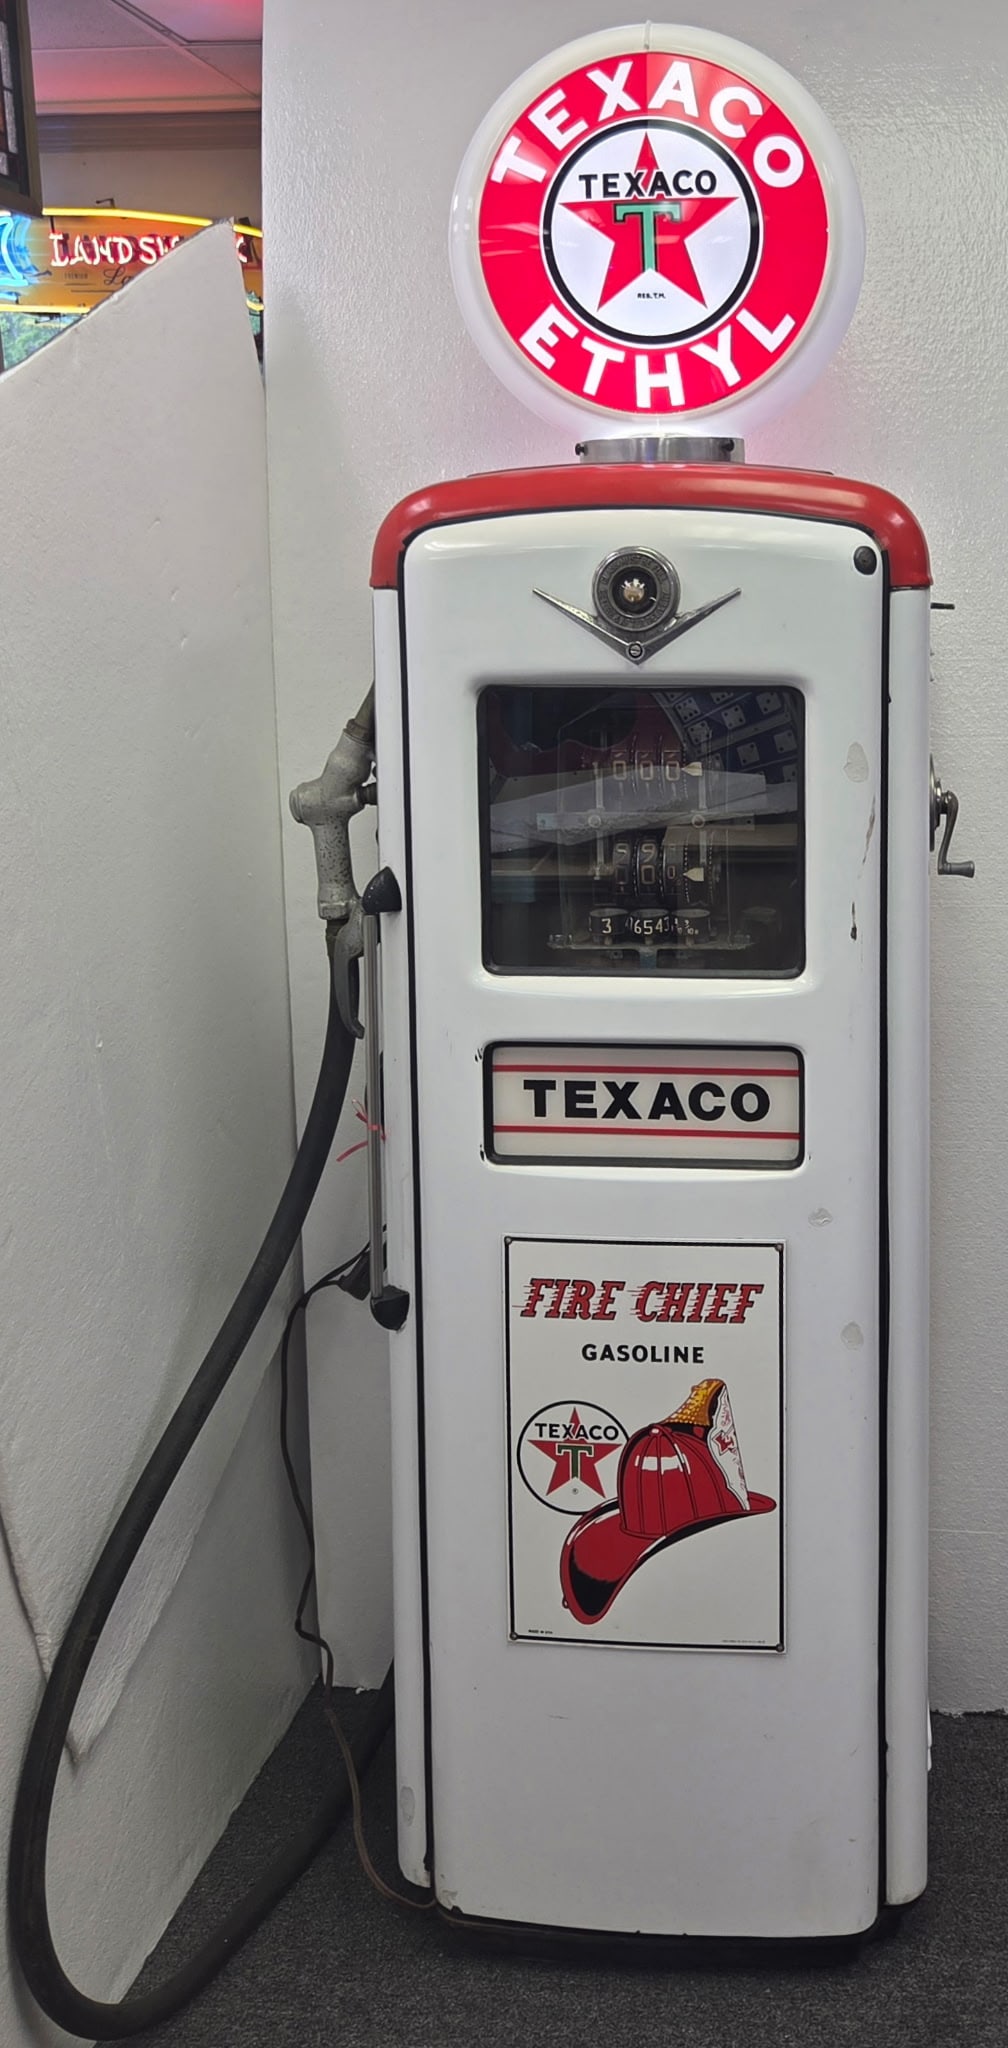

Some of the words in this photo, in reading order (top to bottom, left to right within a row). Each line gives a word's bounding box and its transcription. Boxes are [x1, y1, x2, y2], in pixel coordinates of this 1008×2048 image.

[491, 61, 804, 187] TEXACO
[579, 169, 717, 199] TEXACO
[519, 303, 796, 409] ETHYL
[523, 1079, 771, 1123] TEXACO
[518, 1277, 626, 1322] FIRE
[632, 1280, 766, 1325] CHIEF
[581, 1343, 705, 1365] GASOLINE
[534, 1422, 619, 1441] TEXACO
